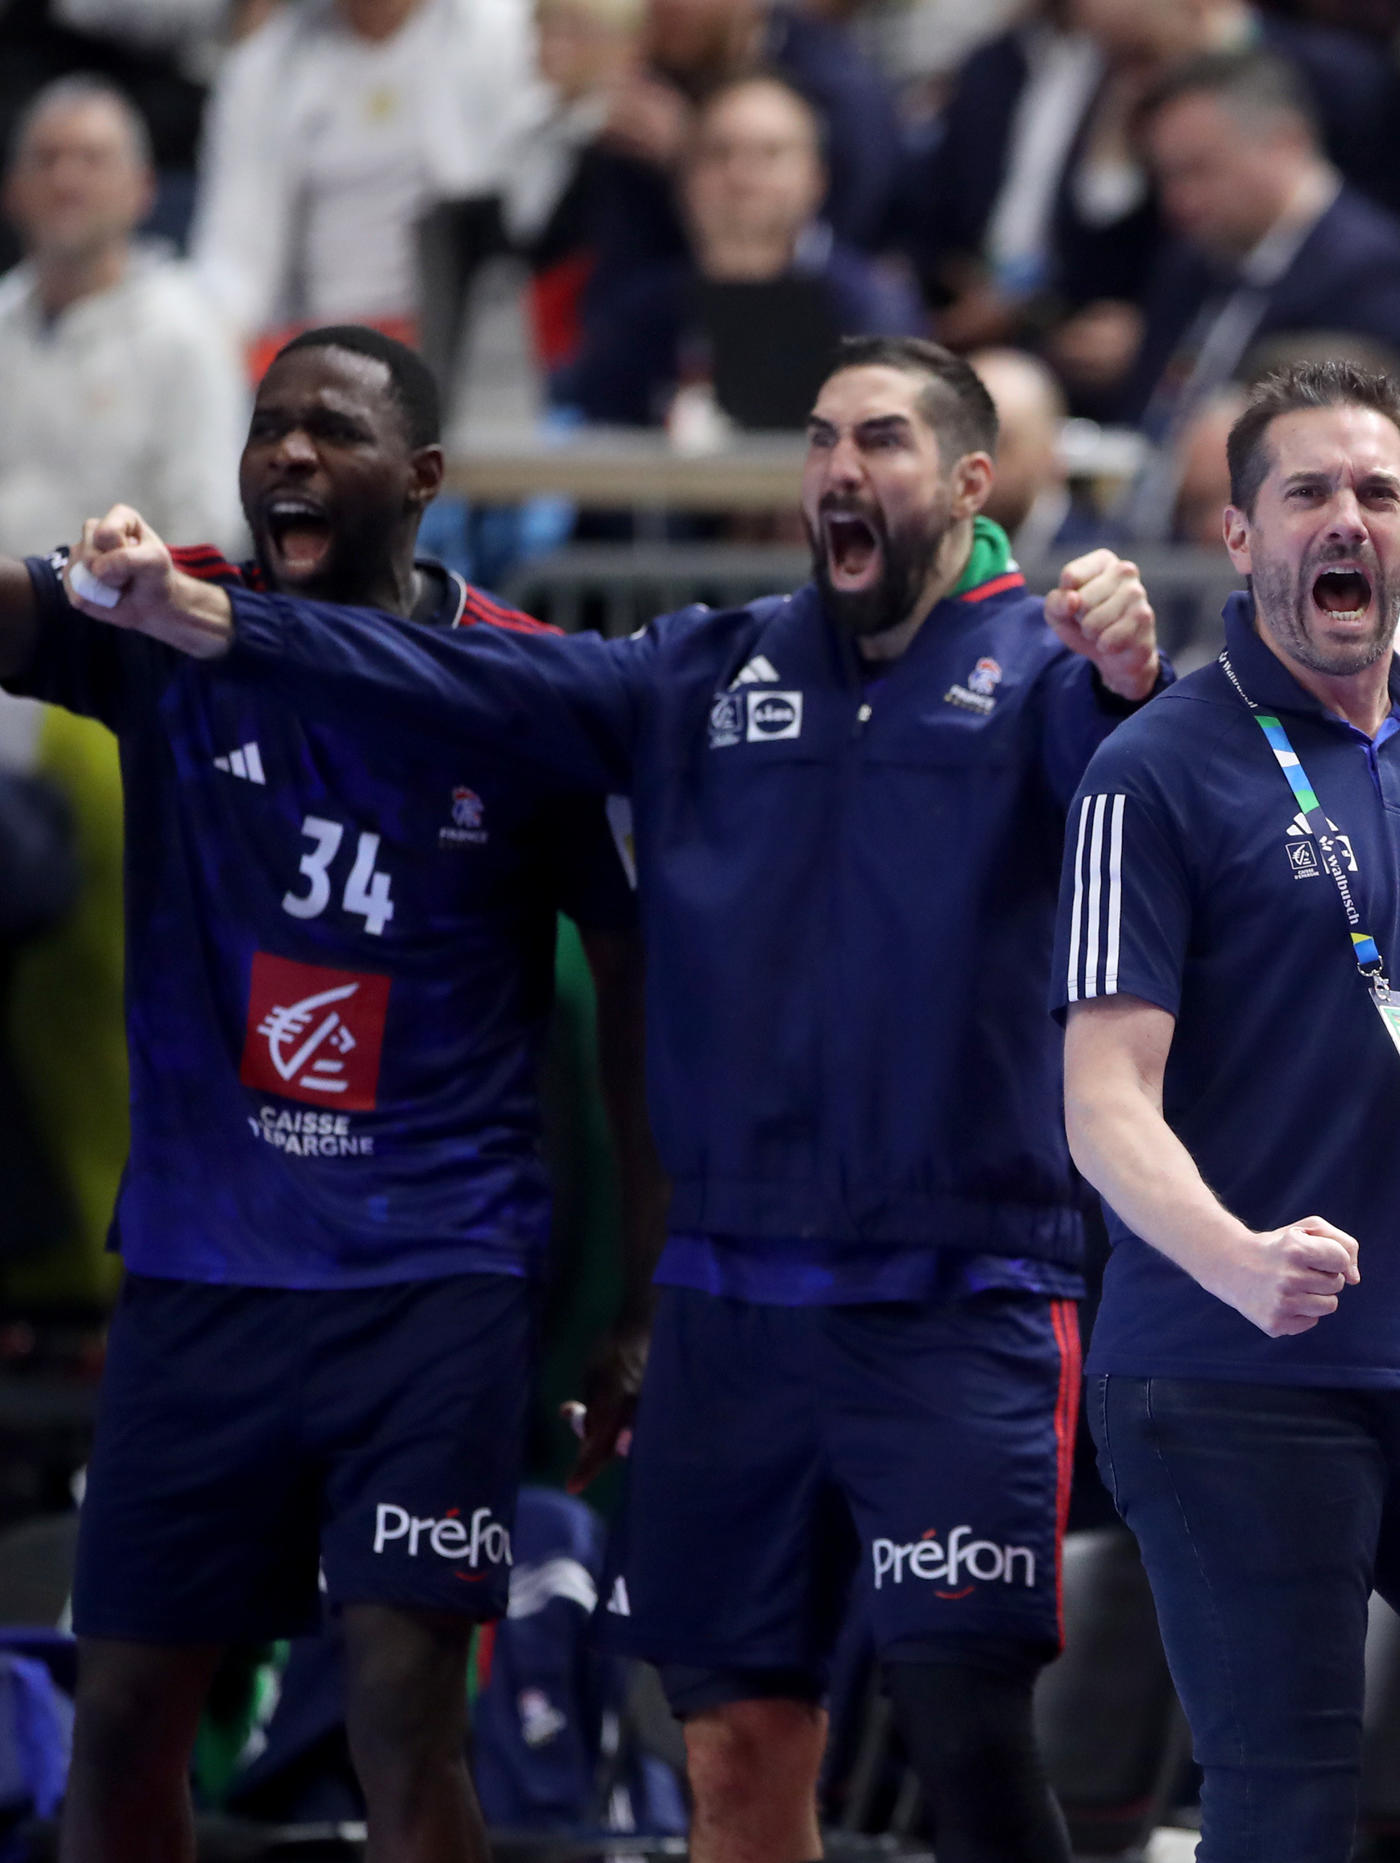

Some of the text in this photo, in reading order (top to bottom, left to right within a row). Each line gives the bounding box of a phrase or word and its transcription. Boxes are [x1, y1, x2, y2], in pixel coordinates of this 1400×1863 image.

[282, 815, 394, 936] 34
[1328, 854, 1360, 925] walbusch
[260, 1105, 351, 1136] CAISSE
